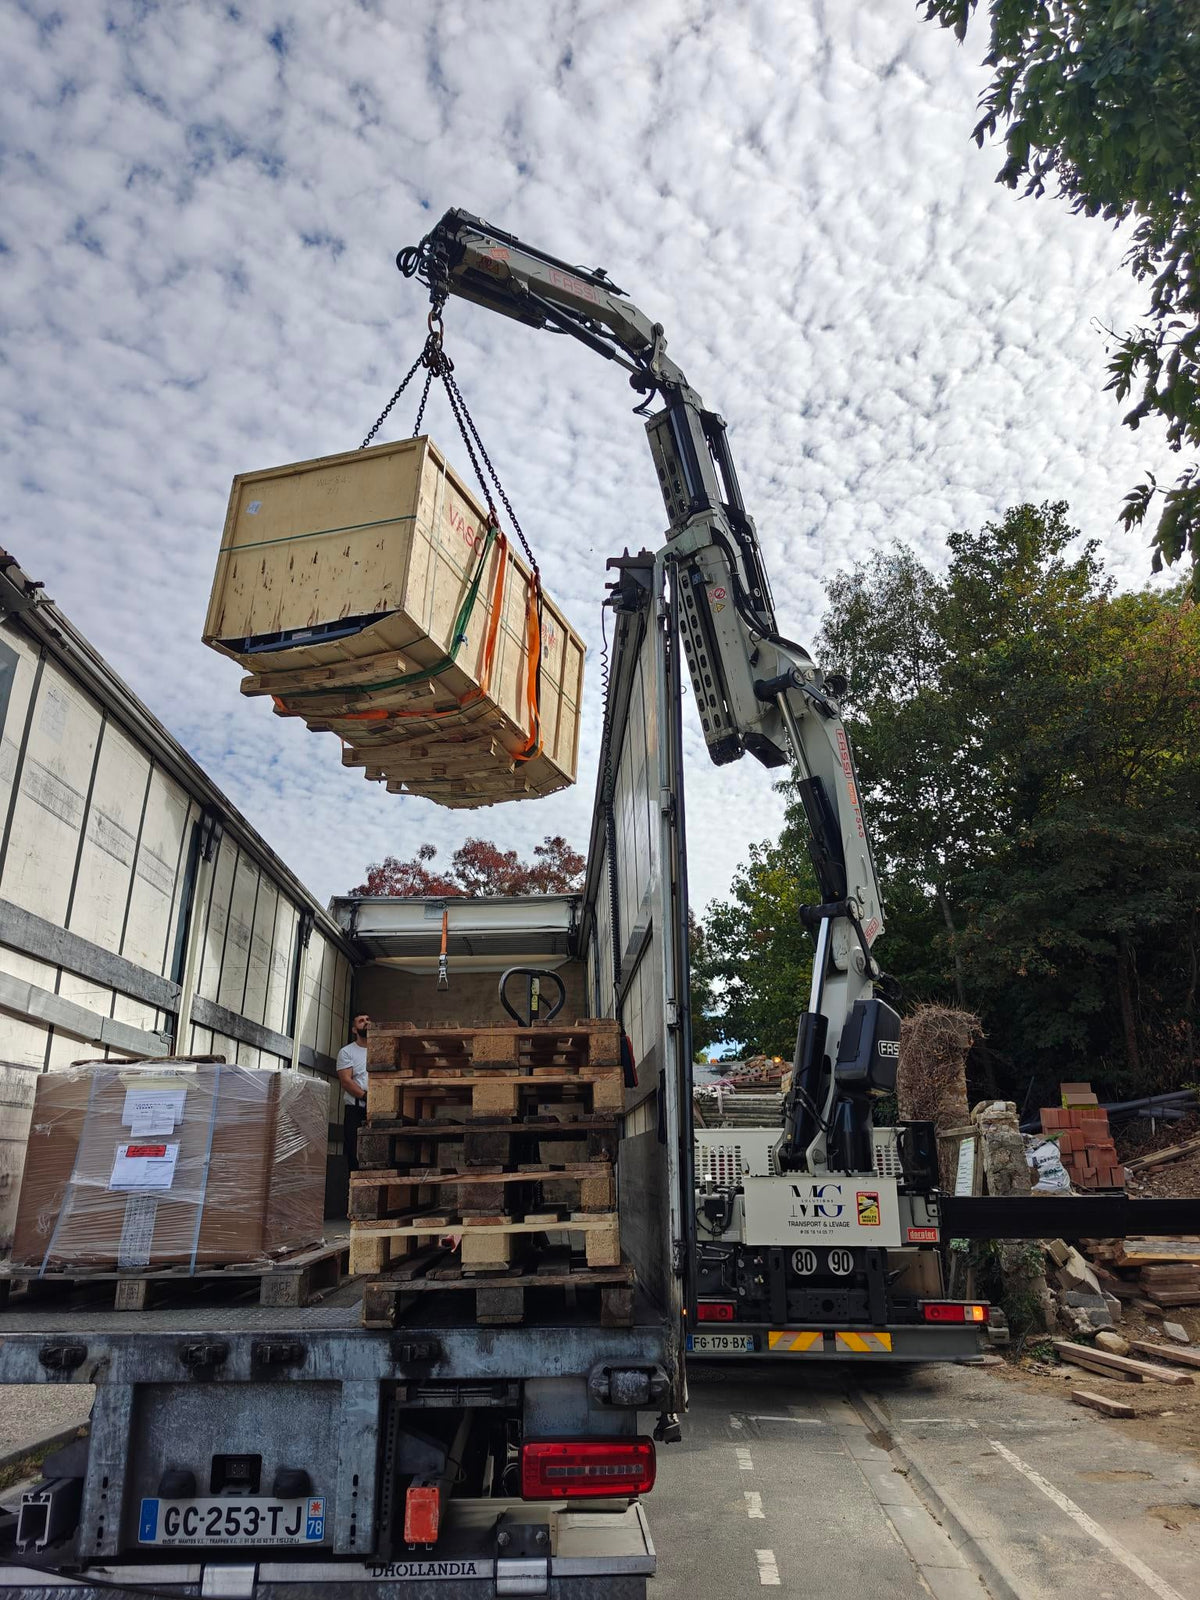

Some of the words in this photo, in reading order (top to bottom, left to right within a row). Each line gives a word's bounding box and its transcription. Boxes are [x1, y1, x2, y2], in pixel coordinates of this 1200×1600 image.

[837, 731, 853, 778] FASSI
[795, 1251, 813, 1272] 80
[832, 1251, 850, 1272] 90
[693, 1337, 746, 1348] FG-179-BX
[164, 1506, 302, 1536] GC-253-TJ
[308, 1520, 323, 1535] 78
[372, 1562, 477, 1578] DHOLLANDIA
